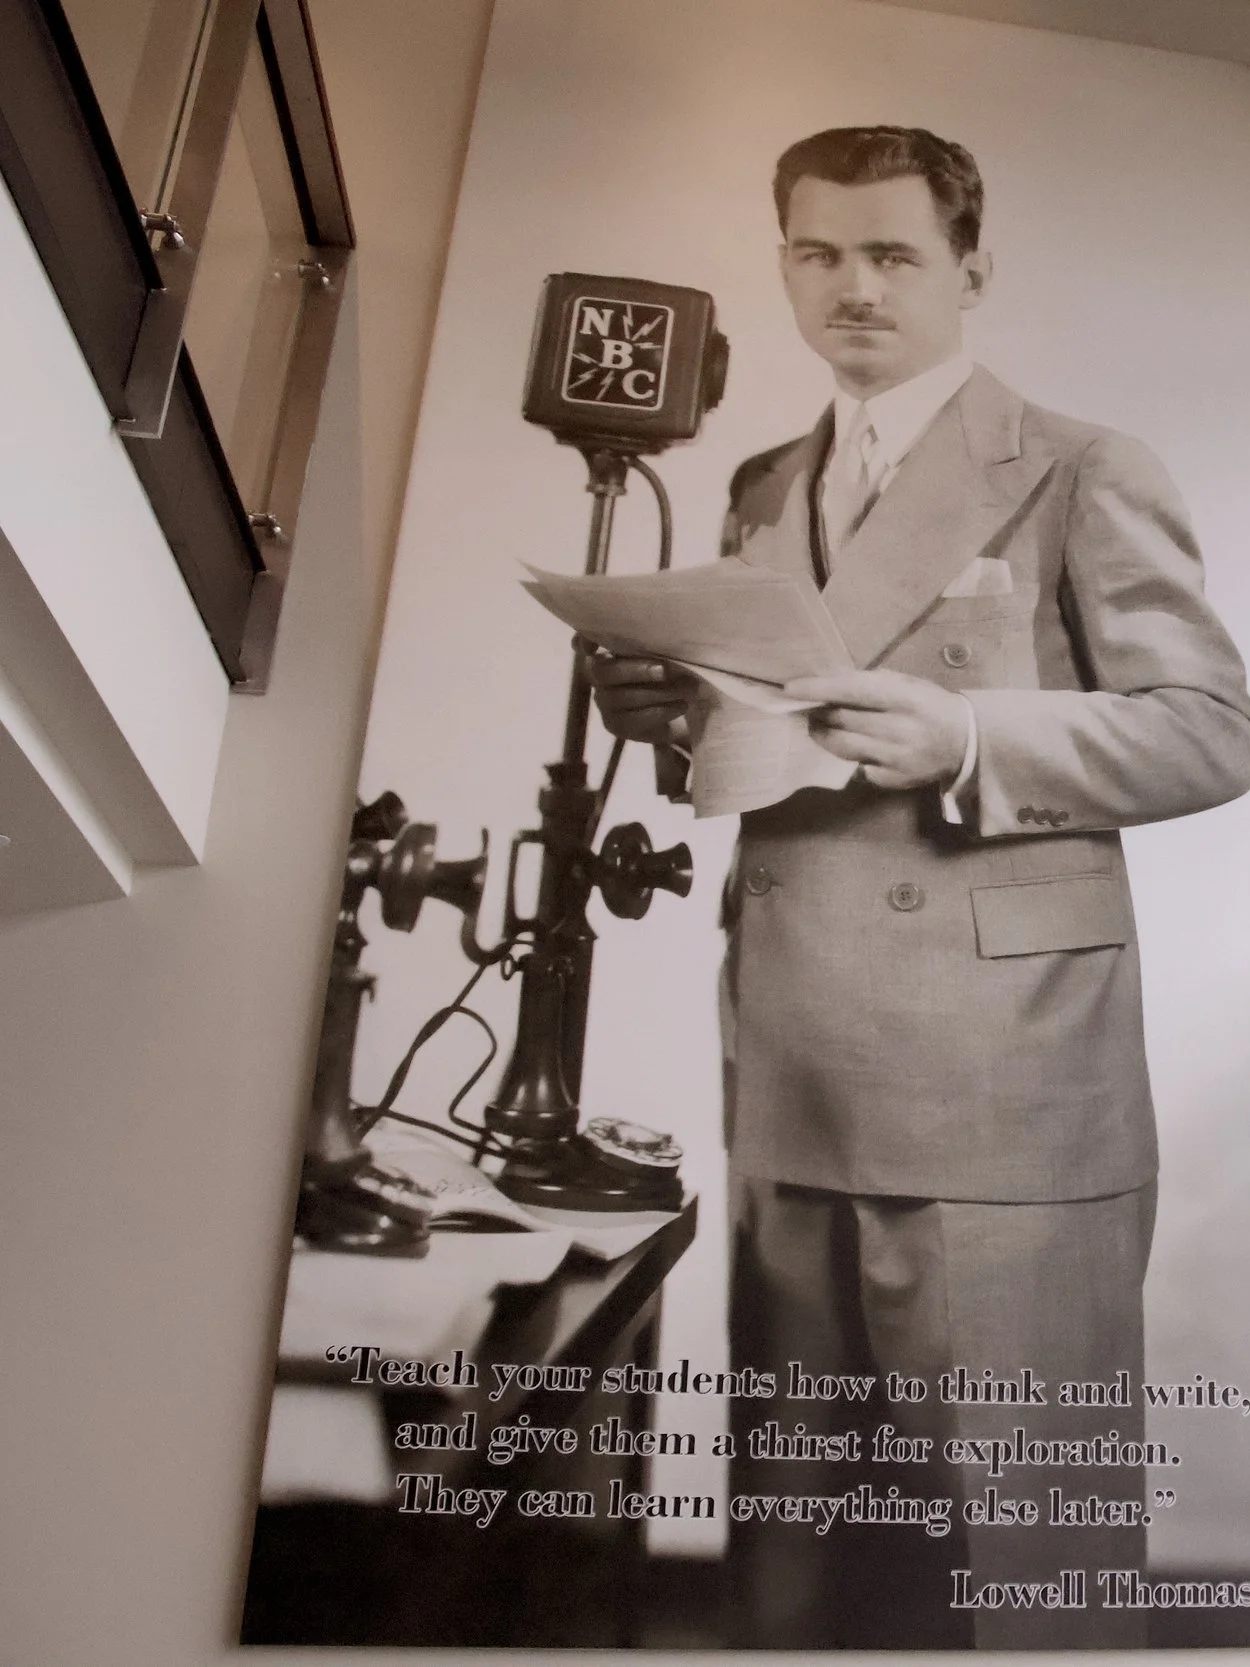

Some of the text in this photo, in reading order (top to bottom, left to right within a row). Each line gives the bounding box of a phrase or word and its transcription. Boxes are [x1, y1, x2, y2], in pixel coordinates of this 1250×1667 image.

[325, 1345, 478, 1387] “Teach
[489, 1362, 592, 1400] your
[602, 1359, 776, 1398] students
[787, 1361, 876, 1401] how
[886, 1372, 927, 1402] to
[938, 1368, 1047, 1405] think
[1058, 1371, 1131, 1407] and
[395, 1412, 1182, 1476] and give them a thirst for exploration.
[396, 1474, 1177, 1537] They can learn everything else later.”
[951, 1570, 1086, 1608] Lowell
